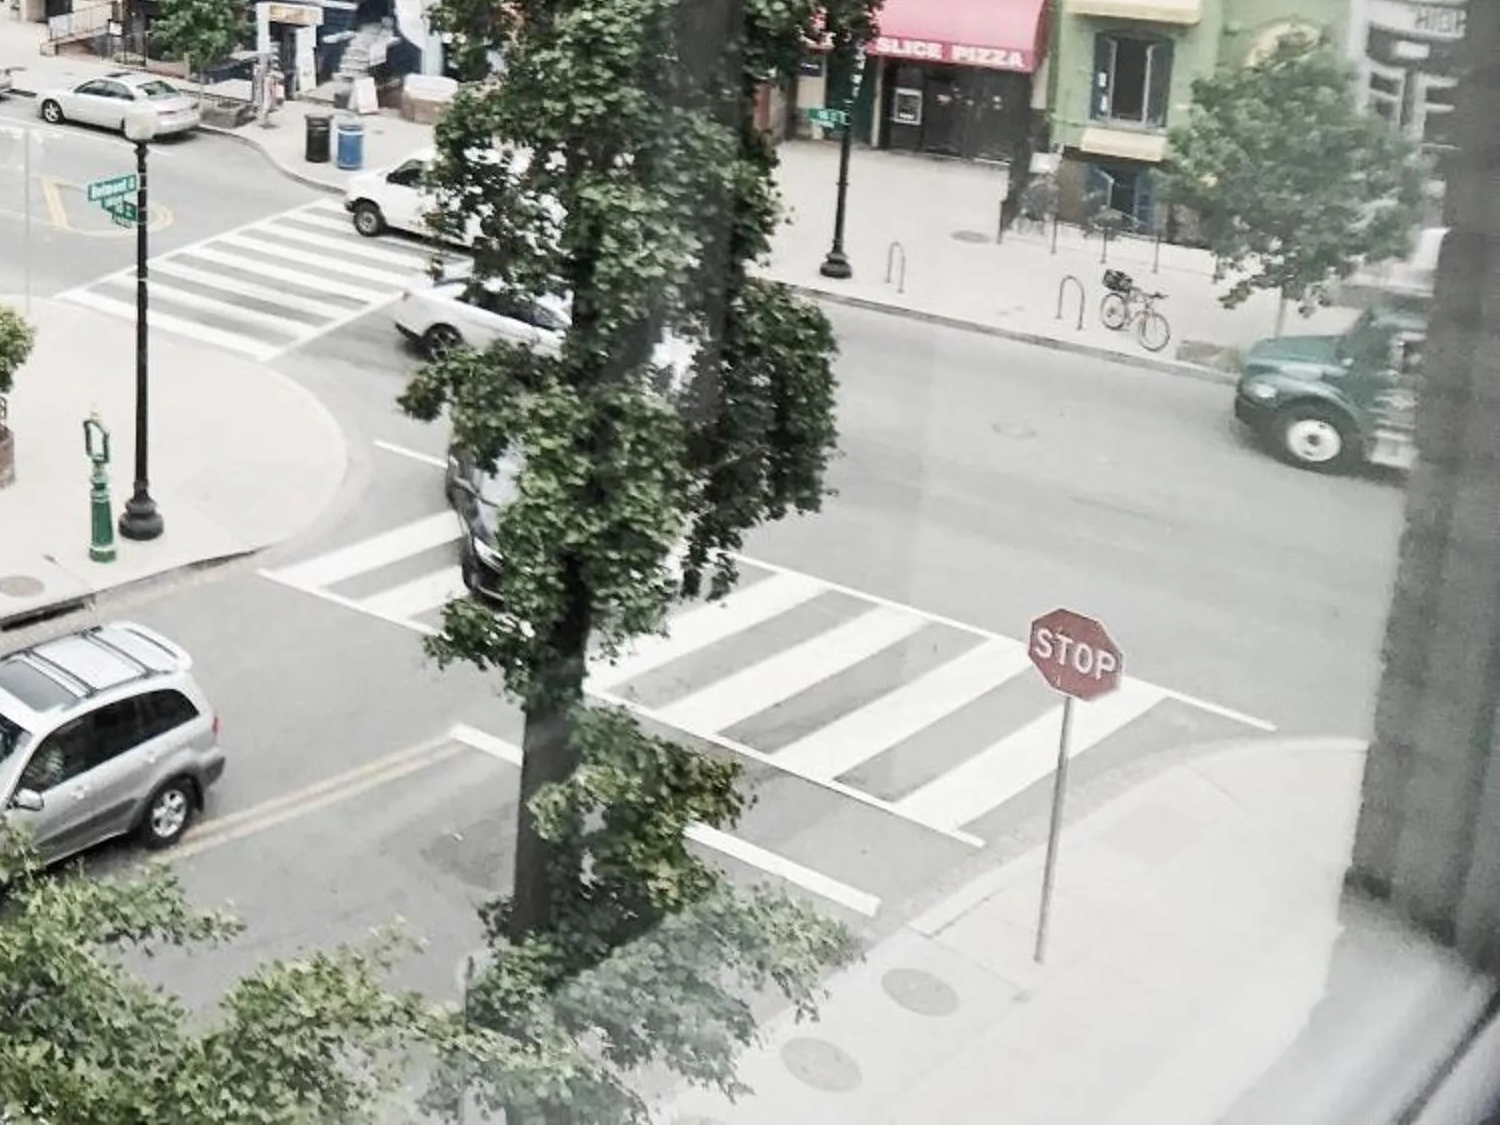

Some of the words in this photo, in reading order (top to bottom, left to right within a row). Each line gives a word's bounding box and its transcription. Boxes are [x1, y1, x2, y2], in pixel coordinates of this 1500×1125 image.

[875, 36, 943, 61] SLICE
[950, 44, 1025, 69] PIZZA
[1034, 628, 1117, 681] STOP
